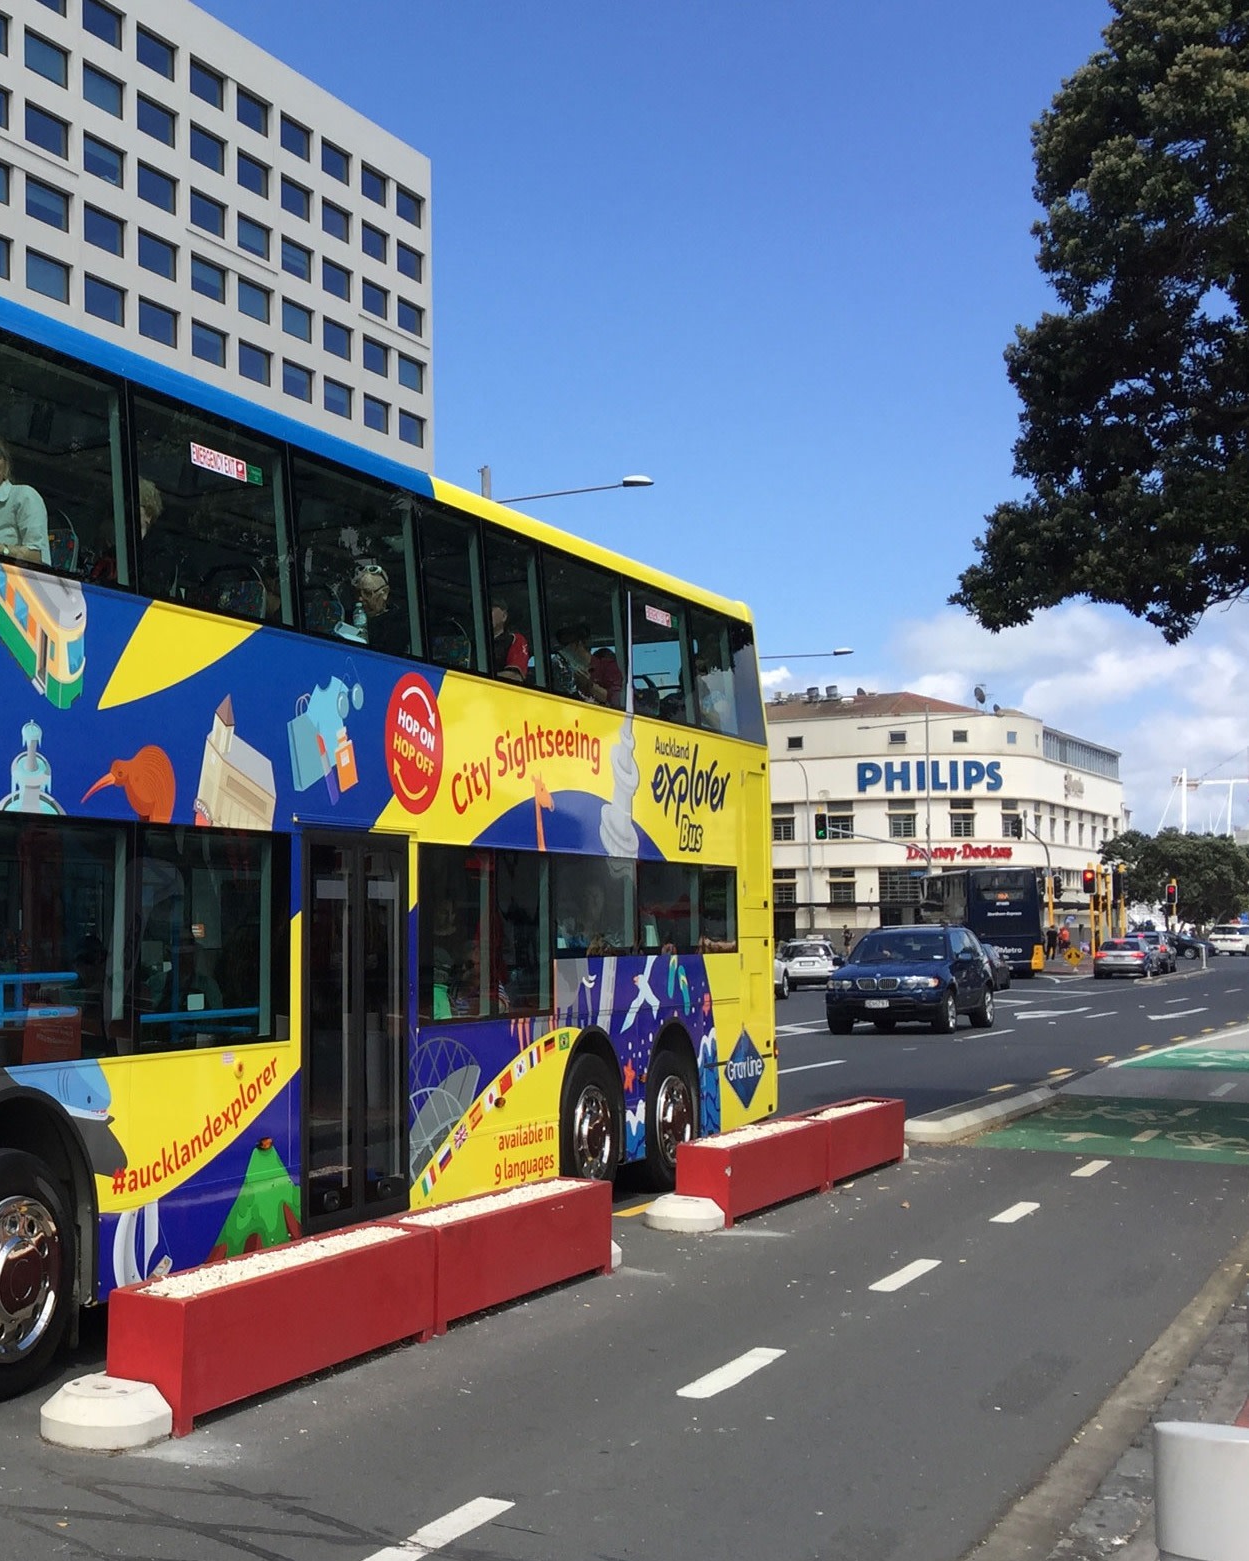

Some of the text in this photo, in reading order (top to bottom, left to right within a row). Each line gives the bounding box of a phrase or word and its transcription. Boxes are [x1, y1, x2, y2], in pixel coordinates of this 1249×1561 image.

[192, 444, 223, 471] EMERGENCY
[224, 456, 236, 476] EXIT
[397, 707, 436, 752] HOP ON
[654, 736, 690, 760] Auckland
[393, 732, 436, 778] HOP OFF
[451, 719, 601, 815] City Sightseeing
[650, 743, 731, 828] explorer
[856, 760, 1004, 793] PHILIPS
[679, 813, 703, 853] Bus
[112, 1057, 278, 1195] #aucklandexplorer
[498, 1121, 554, 1151] available in
[494, 1154, 555, 1186] 9 languages
